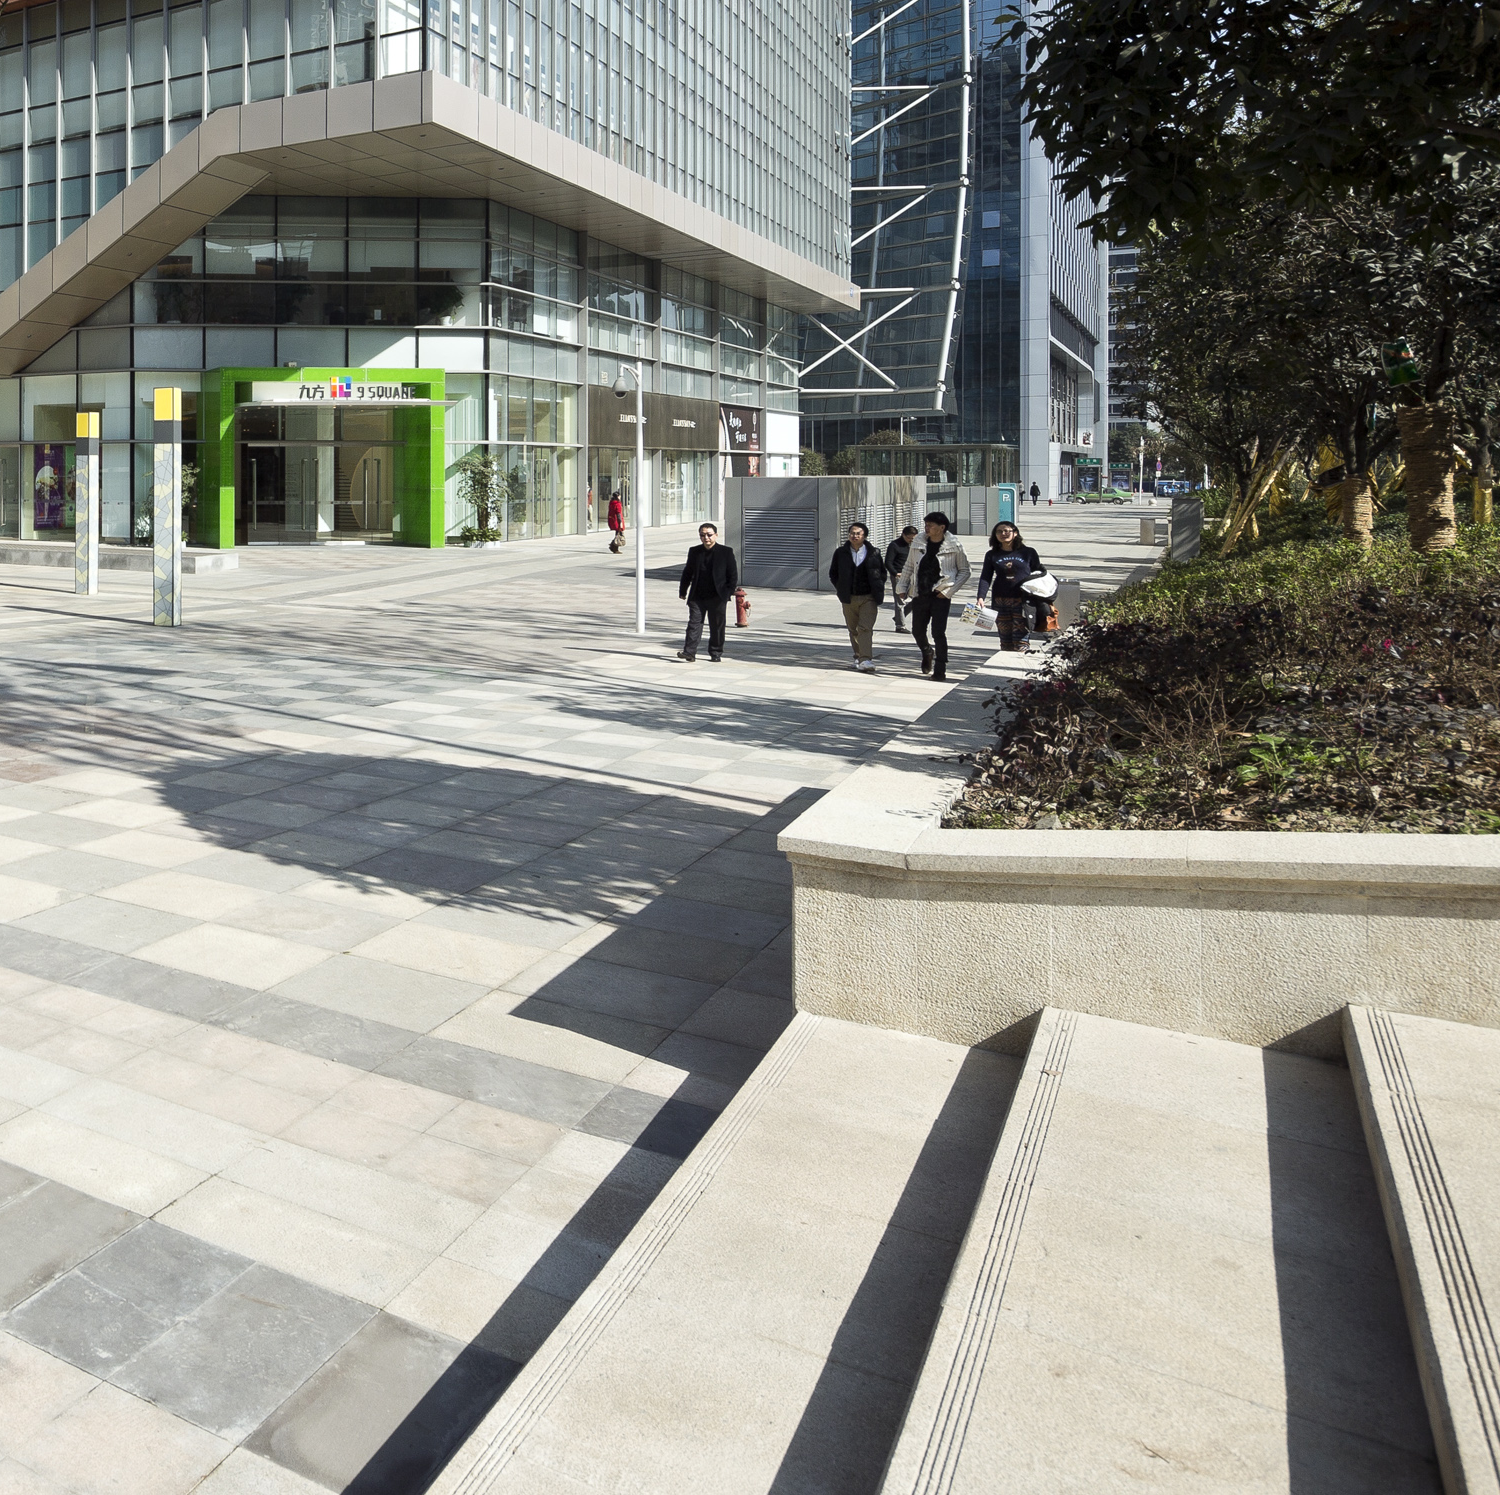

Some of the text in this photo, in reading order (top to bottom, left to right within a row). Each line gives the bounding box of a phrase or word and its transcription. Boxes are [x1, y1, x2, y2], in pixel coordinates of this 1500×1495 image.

[299, 384, 325, 399] 九方
[357, 385, 416, 400] 9 SQUARE
[1002, 493, 1010, 502] P
